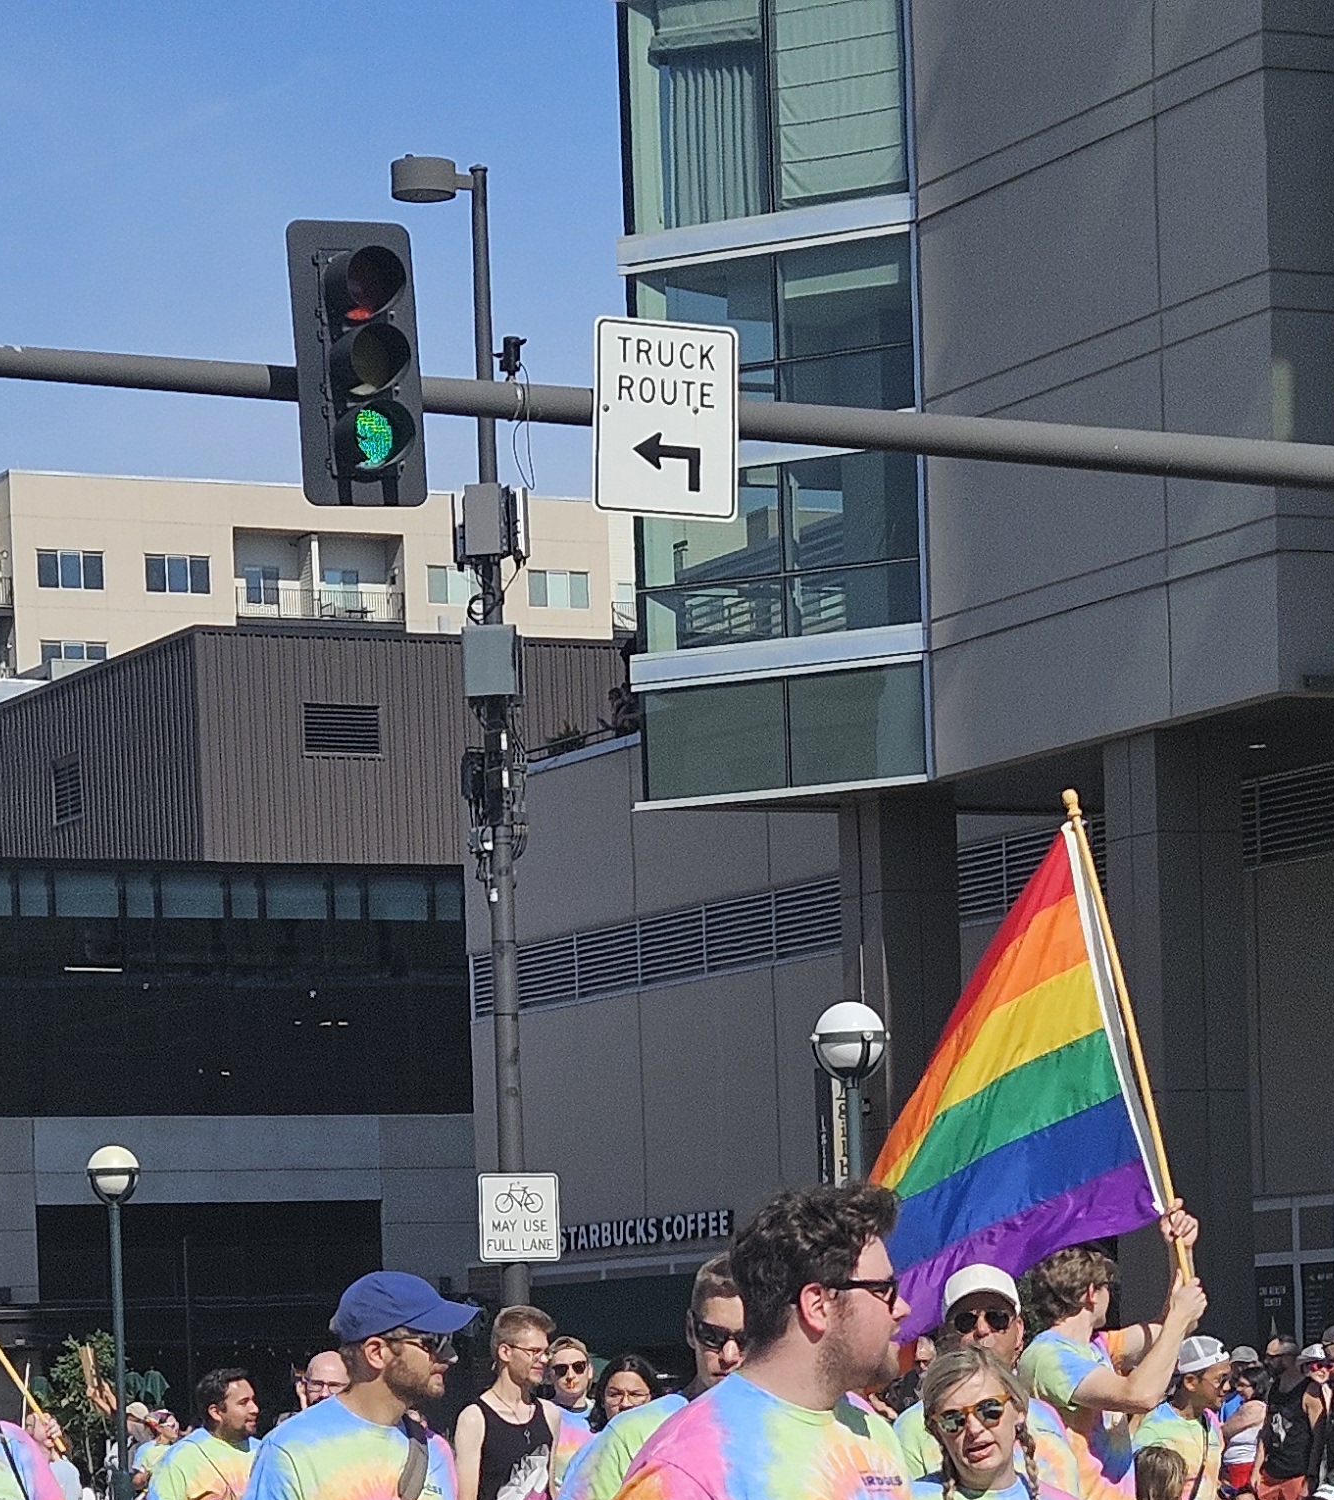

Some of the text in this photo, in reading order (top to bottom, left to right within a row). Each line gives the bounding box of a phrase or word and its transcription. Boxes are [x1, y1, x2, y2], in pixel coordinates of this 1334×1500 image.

[617, 336, 715, 371] TRUCK
[617, 374, 715, 409] ROUTE
[492, 1219, 548, 1233] MAY USE
[662, 1210, 729, 1241] COFFEE
[487, 1238, 554, 1252] FULL LANE
